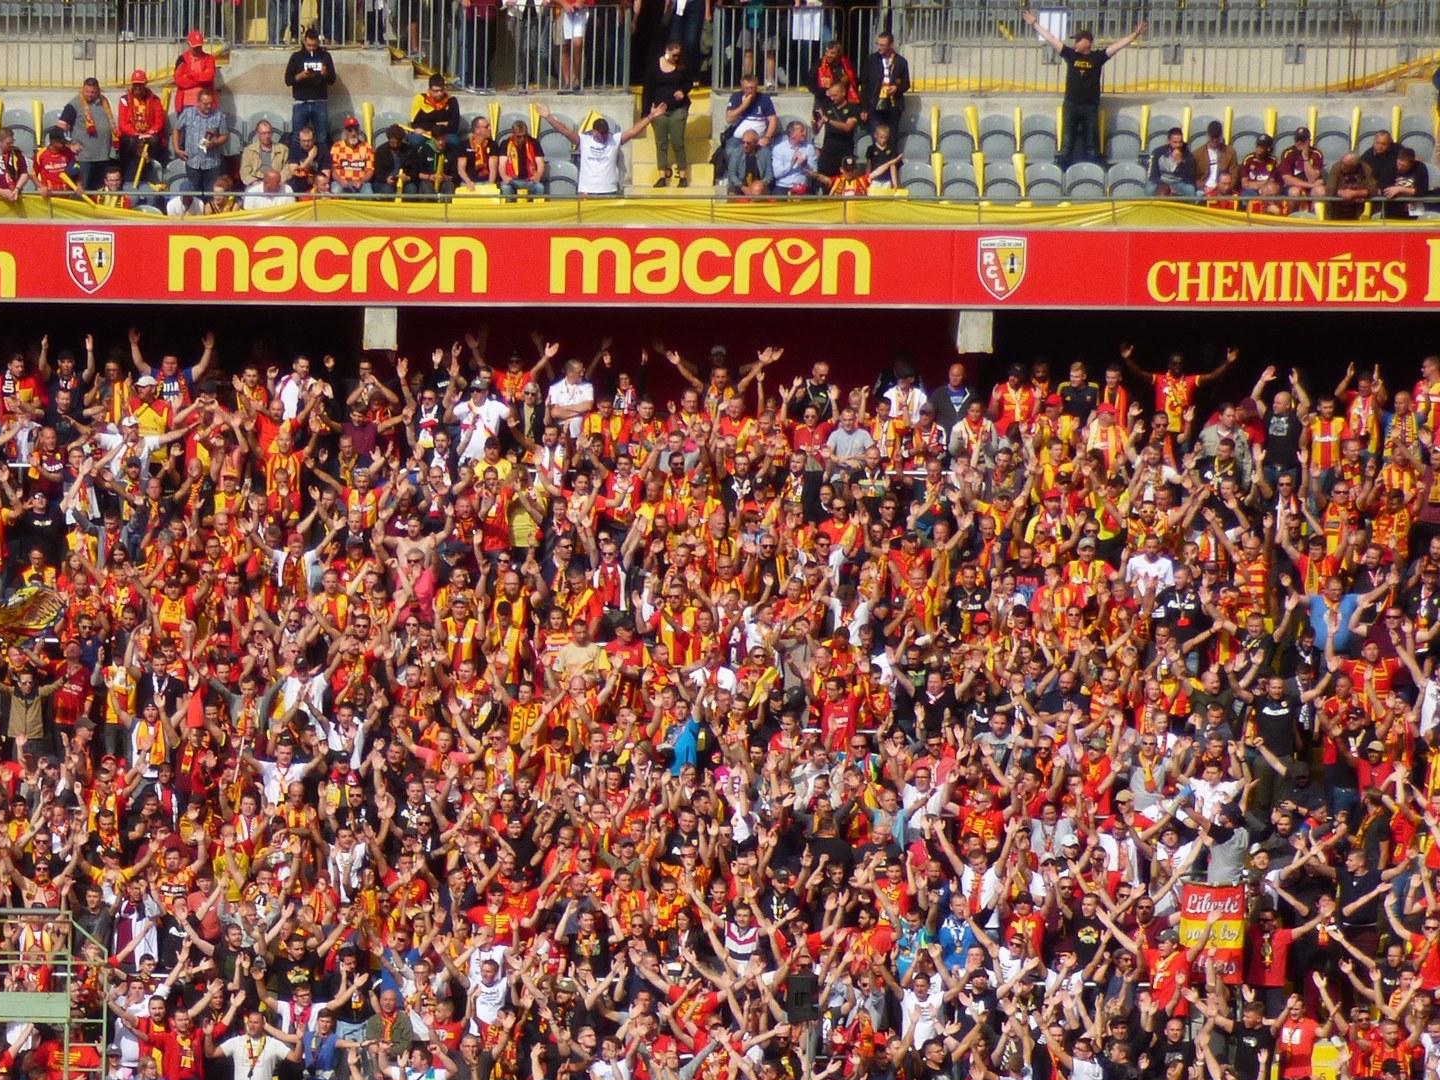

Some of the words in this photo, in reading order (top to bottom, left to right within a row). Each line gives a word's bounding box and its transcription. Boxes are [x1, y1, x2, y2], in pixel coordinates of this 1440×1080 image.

[168, 235, 488, 295] macron
[549, 236, 872, 296] macron
[1146, 252, 1408, 303] CHEMINÉES
[1186, 892, 1241, 914] Liberté
